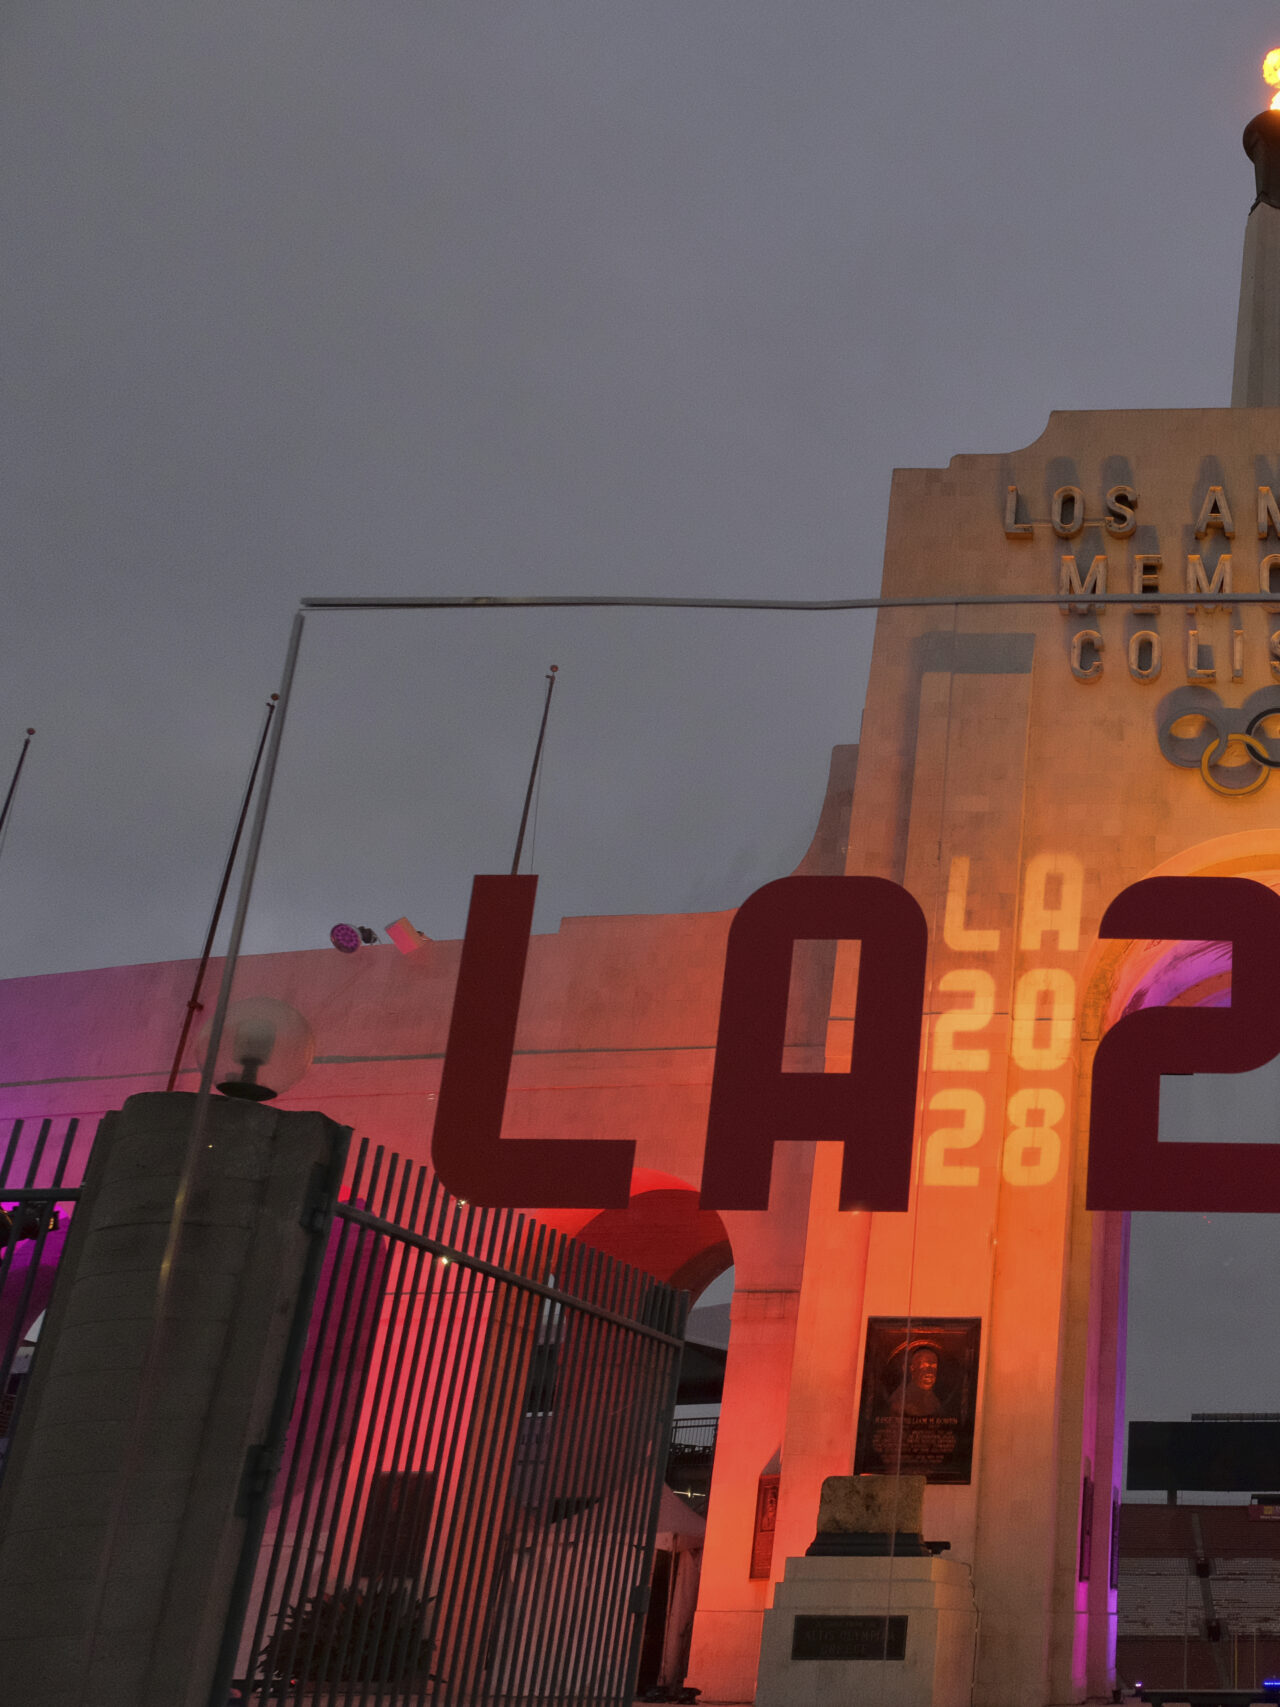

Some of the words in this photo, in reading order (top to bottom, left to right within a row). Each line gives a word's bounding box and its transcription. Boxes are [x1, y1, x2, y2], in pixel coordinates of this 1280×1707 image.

[1004, 486, 1138, 539] LOS
[943, 853, 1084, 952] LA
[932, 968, 1075, 1072] 20
[923, 1087, 1065, 1187] 28
